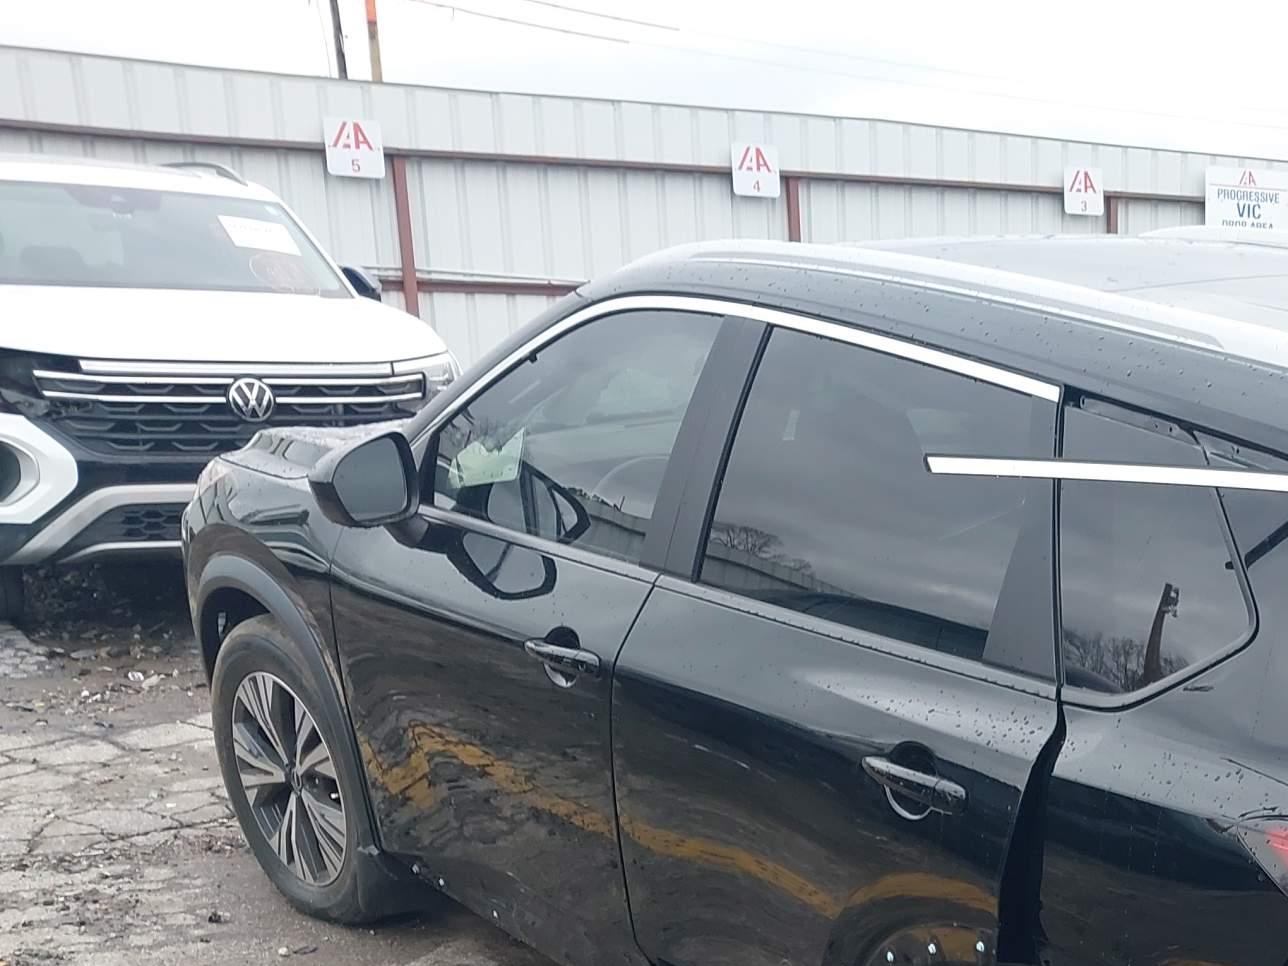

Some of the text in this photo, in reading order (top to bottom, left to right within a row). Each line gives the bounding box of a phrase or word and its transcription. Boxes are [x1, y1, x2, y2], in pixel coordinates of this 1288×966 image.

[351, 158, 361, 173] 5
[752, 179, 761, 192] 4
[1217, 188, 1280, 204] PROGRESSIVE
[1081, 200, 1087, 212] 3
[1237, 202, 1262, 219] VIC
